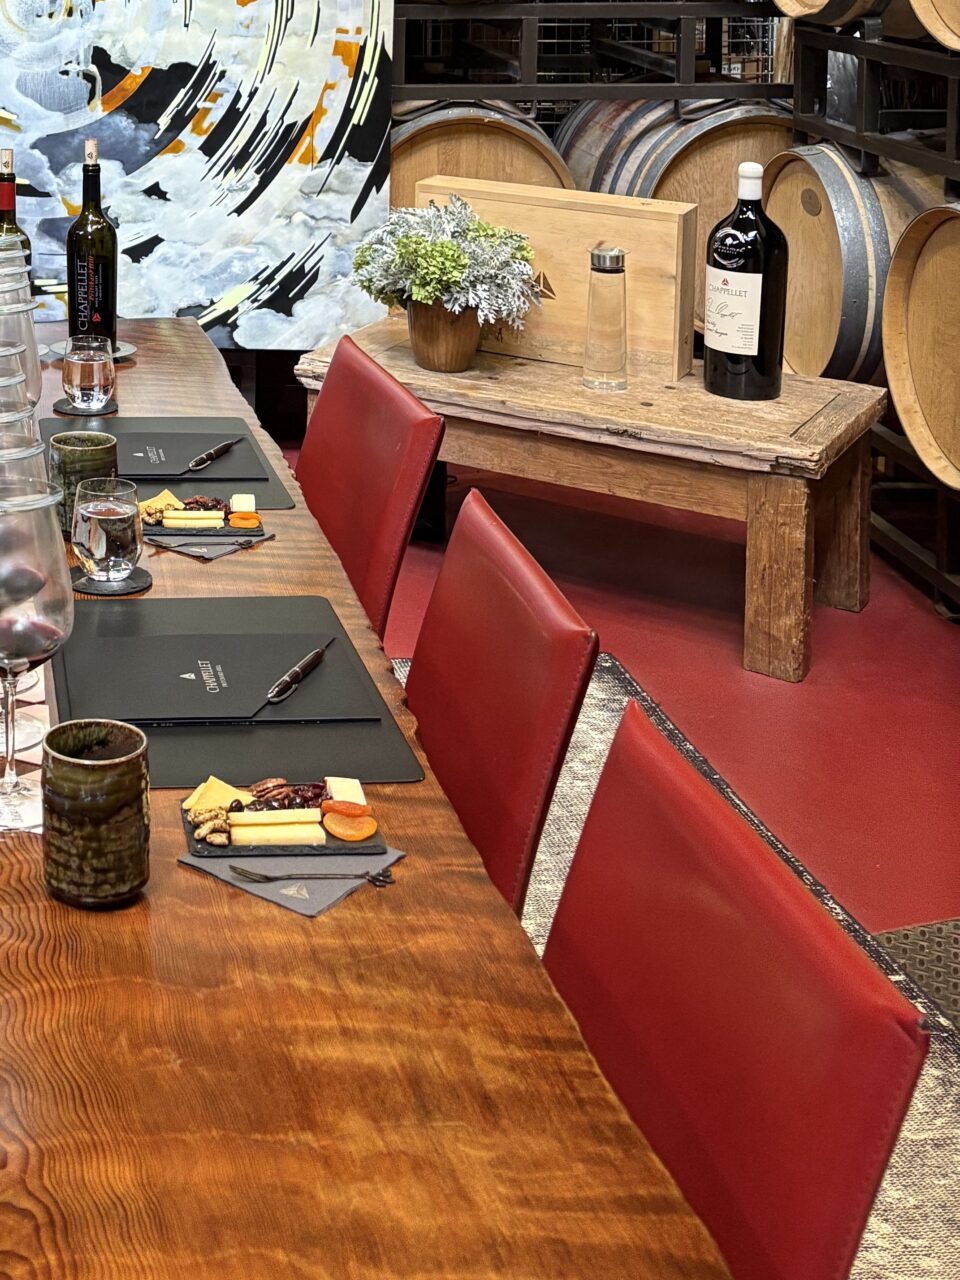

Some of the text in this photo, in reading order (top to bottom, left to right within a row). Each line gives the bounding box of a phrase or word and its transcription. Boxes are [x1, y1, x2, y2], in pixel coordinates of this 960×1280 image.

[77, 259, 88, 331] CHAPPELLET
[709, 283, 748, 298] CHAPPELLET
[197, 660, 220, 693] CHAPPELLET
